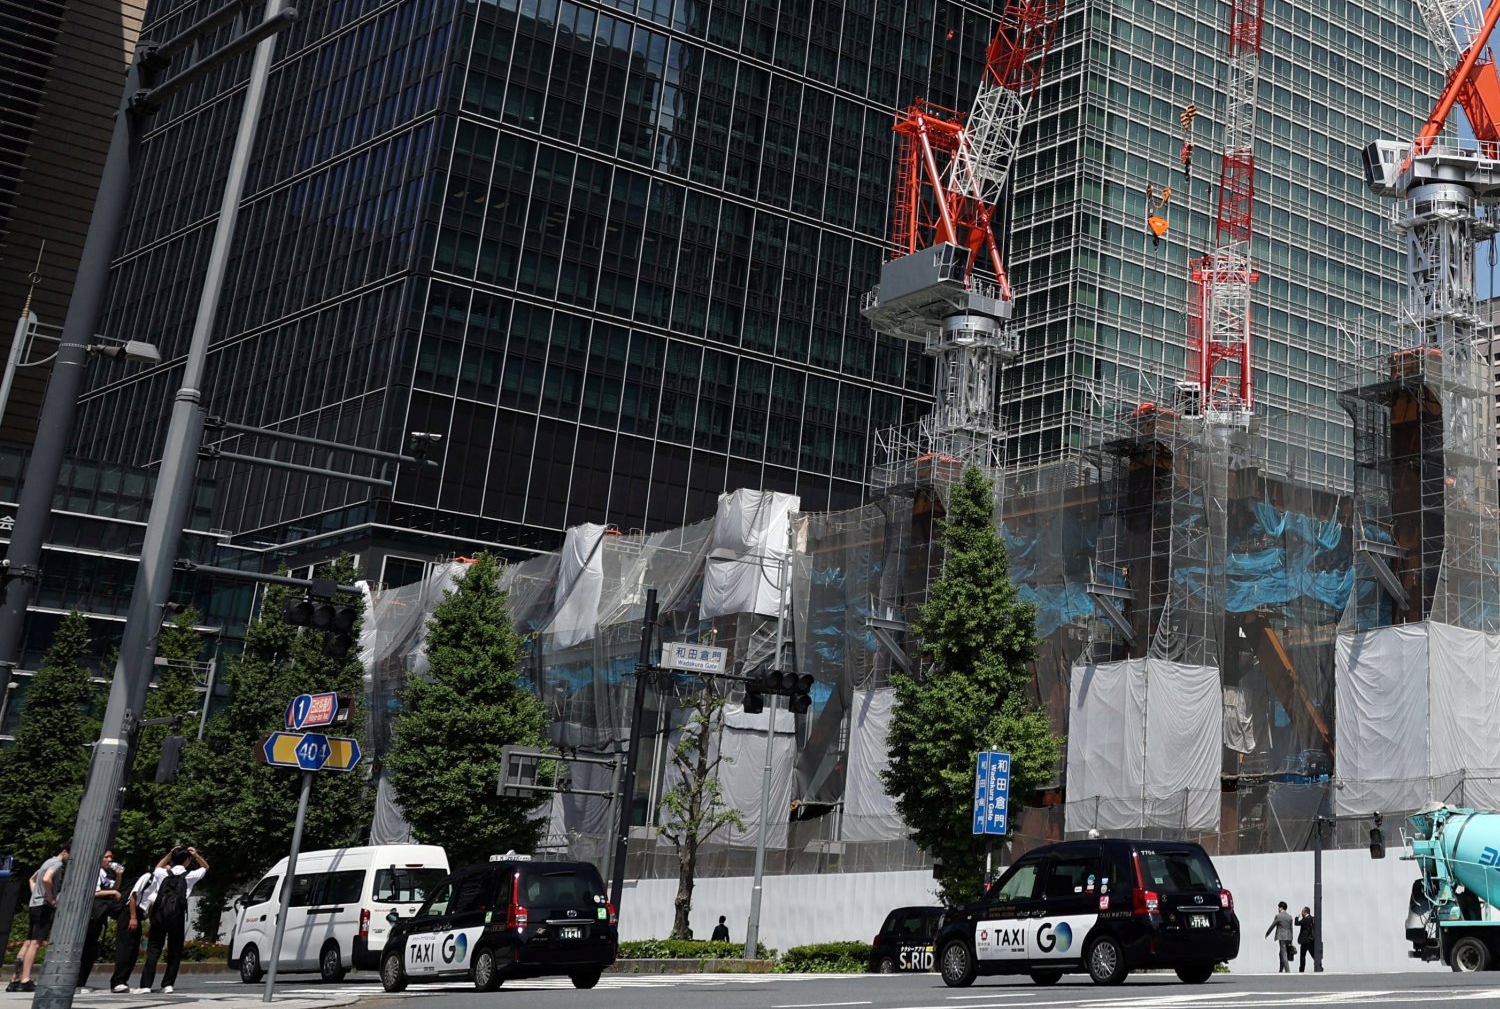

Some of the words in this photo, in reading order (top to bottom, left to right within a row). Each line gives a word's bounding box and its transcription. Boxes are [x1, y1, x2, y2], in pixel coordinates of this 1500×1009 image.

[675, 646, 722, 663] 和田倉門
[677, 659, 704, 668] Wadakura
[705, 662, 718, 670] Gate
[299, 699, 305, 720] 1
[987, 764, 998, 801] Wadakura
[993, 759, 1009, 828] 和田倉門
[987, 803, 995, 821] Gate
[410, 943, 435, 964] TAXI
[441, 932, 468, 964] GO
[994, 928, 1025, 946] TAXI
[1036, 921, 1073, 953] GO
